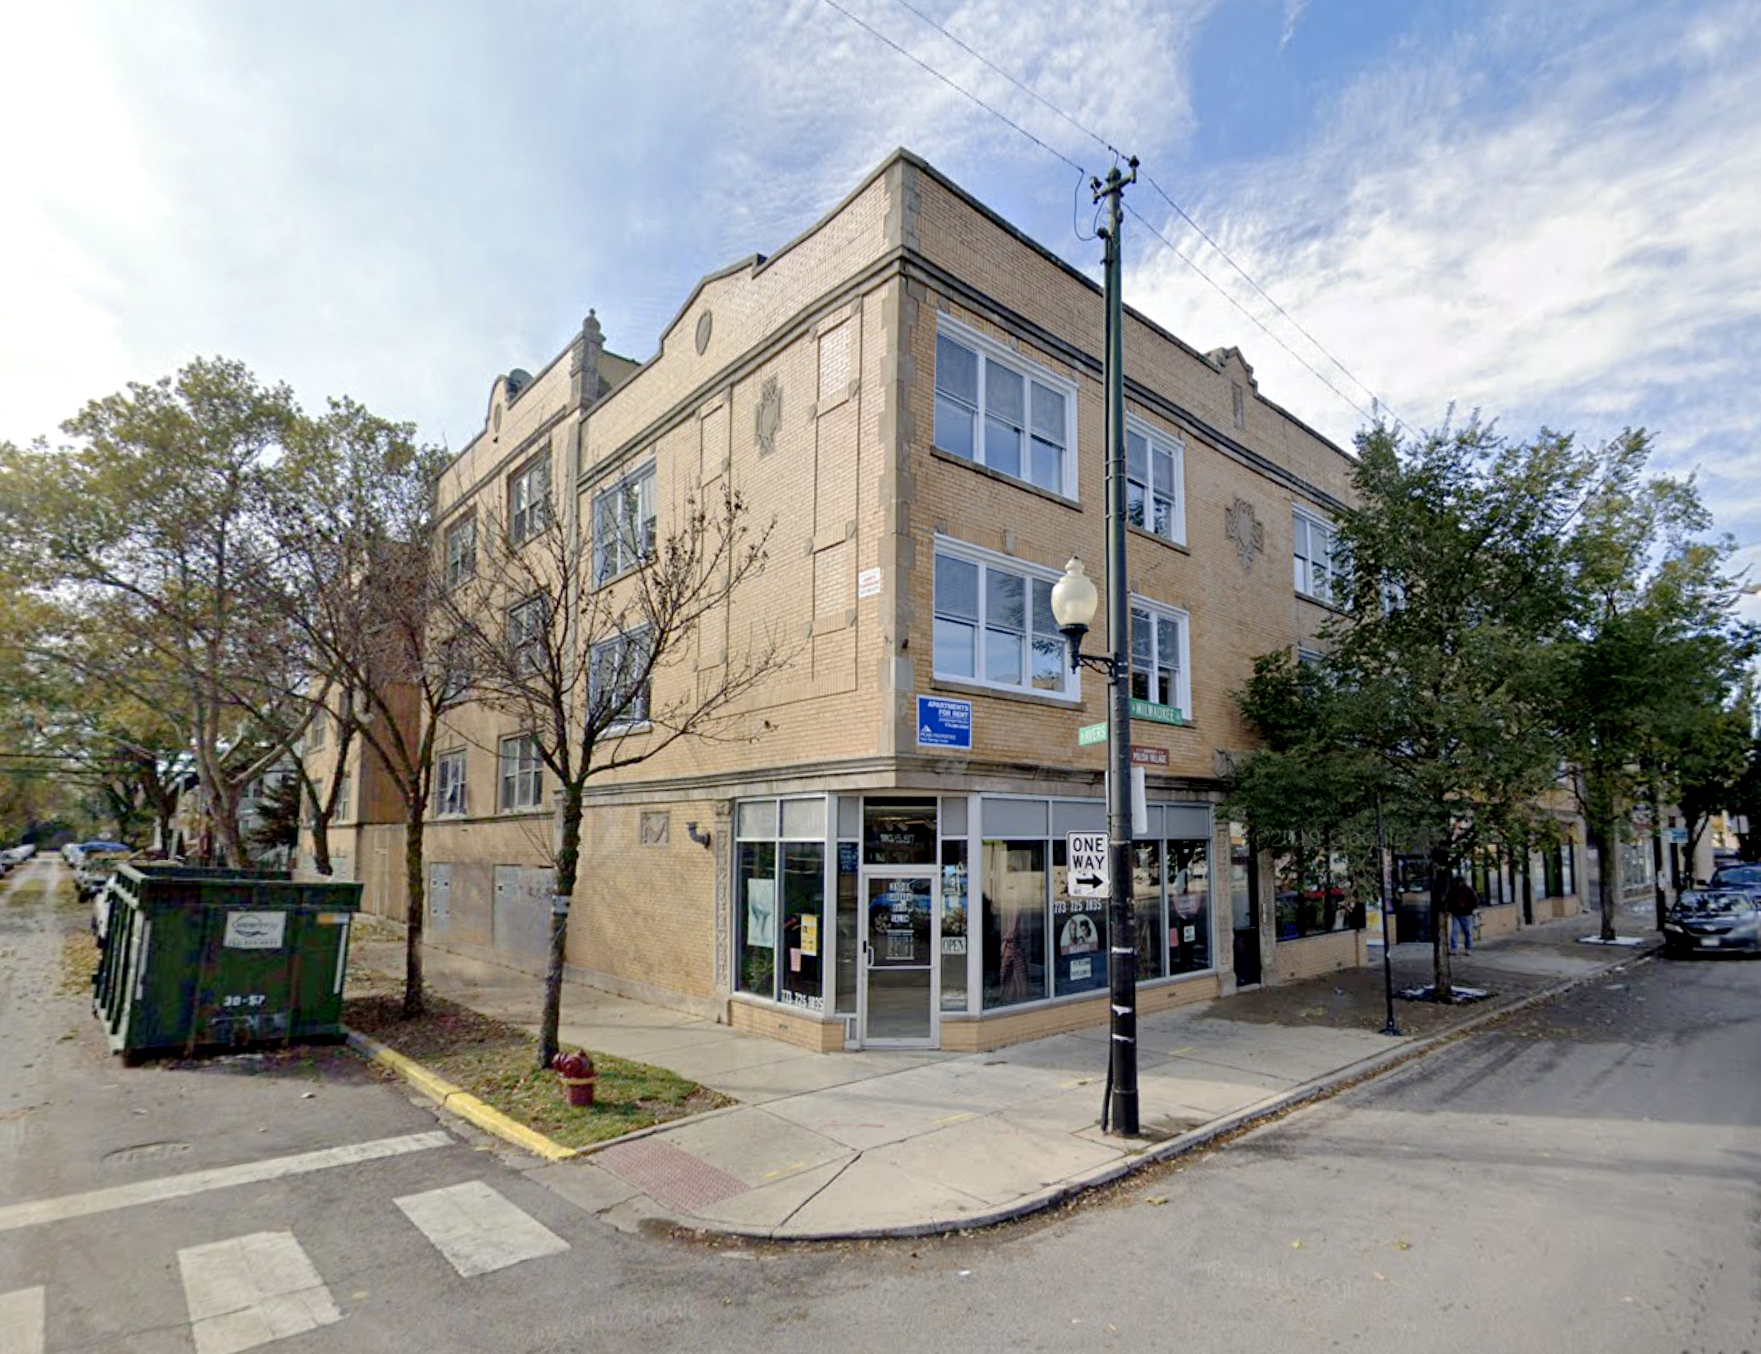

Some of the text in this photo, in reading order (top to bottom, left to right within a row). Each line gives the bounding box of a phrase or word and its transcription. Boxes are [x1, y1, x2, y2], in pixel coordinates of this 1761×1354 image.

[927, 700, 969, 711] APARTMENTS
[1136, 701, 1175, 723] MILWAUKEE
[938, 709, 951, 718] FOR
[952, 711, 969, 721] RENT
[1073, 837, 1104, 852] ONE
[1072, 855, 1105, 870] WAY
[942, 938, 964, 952] OPEN
